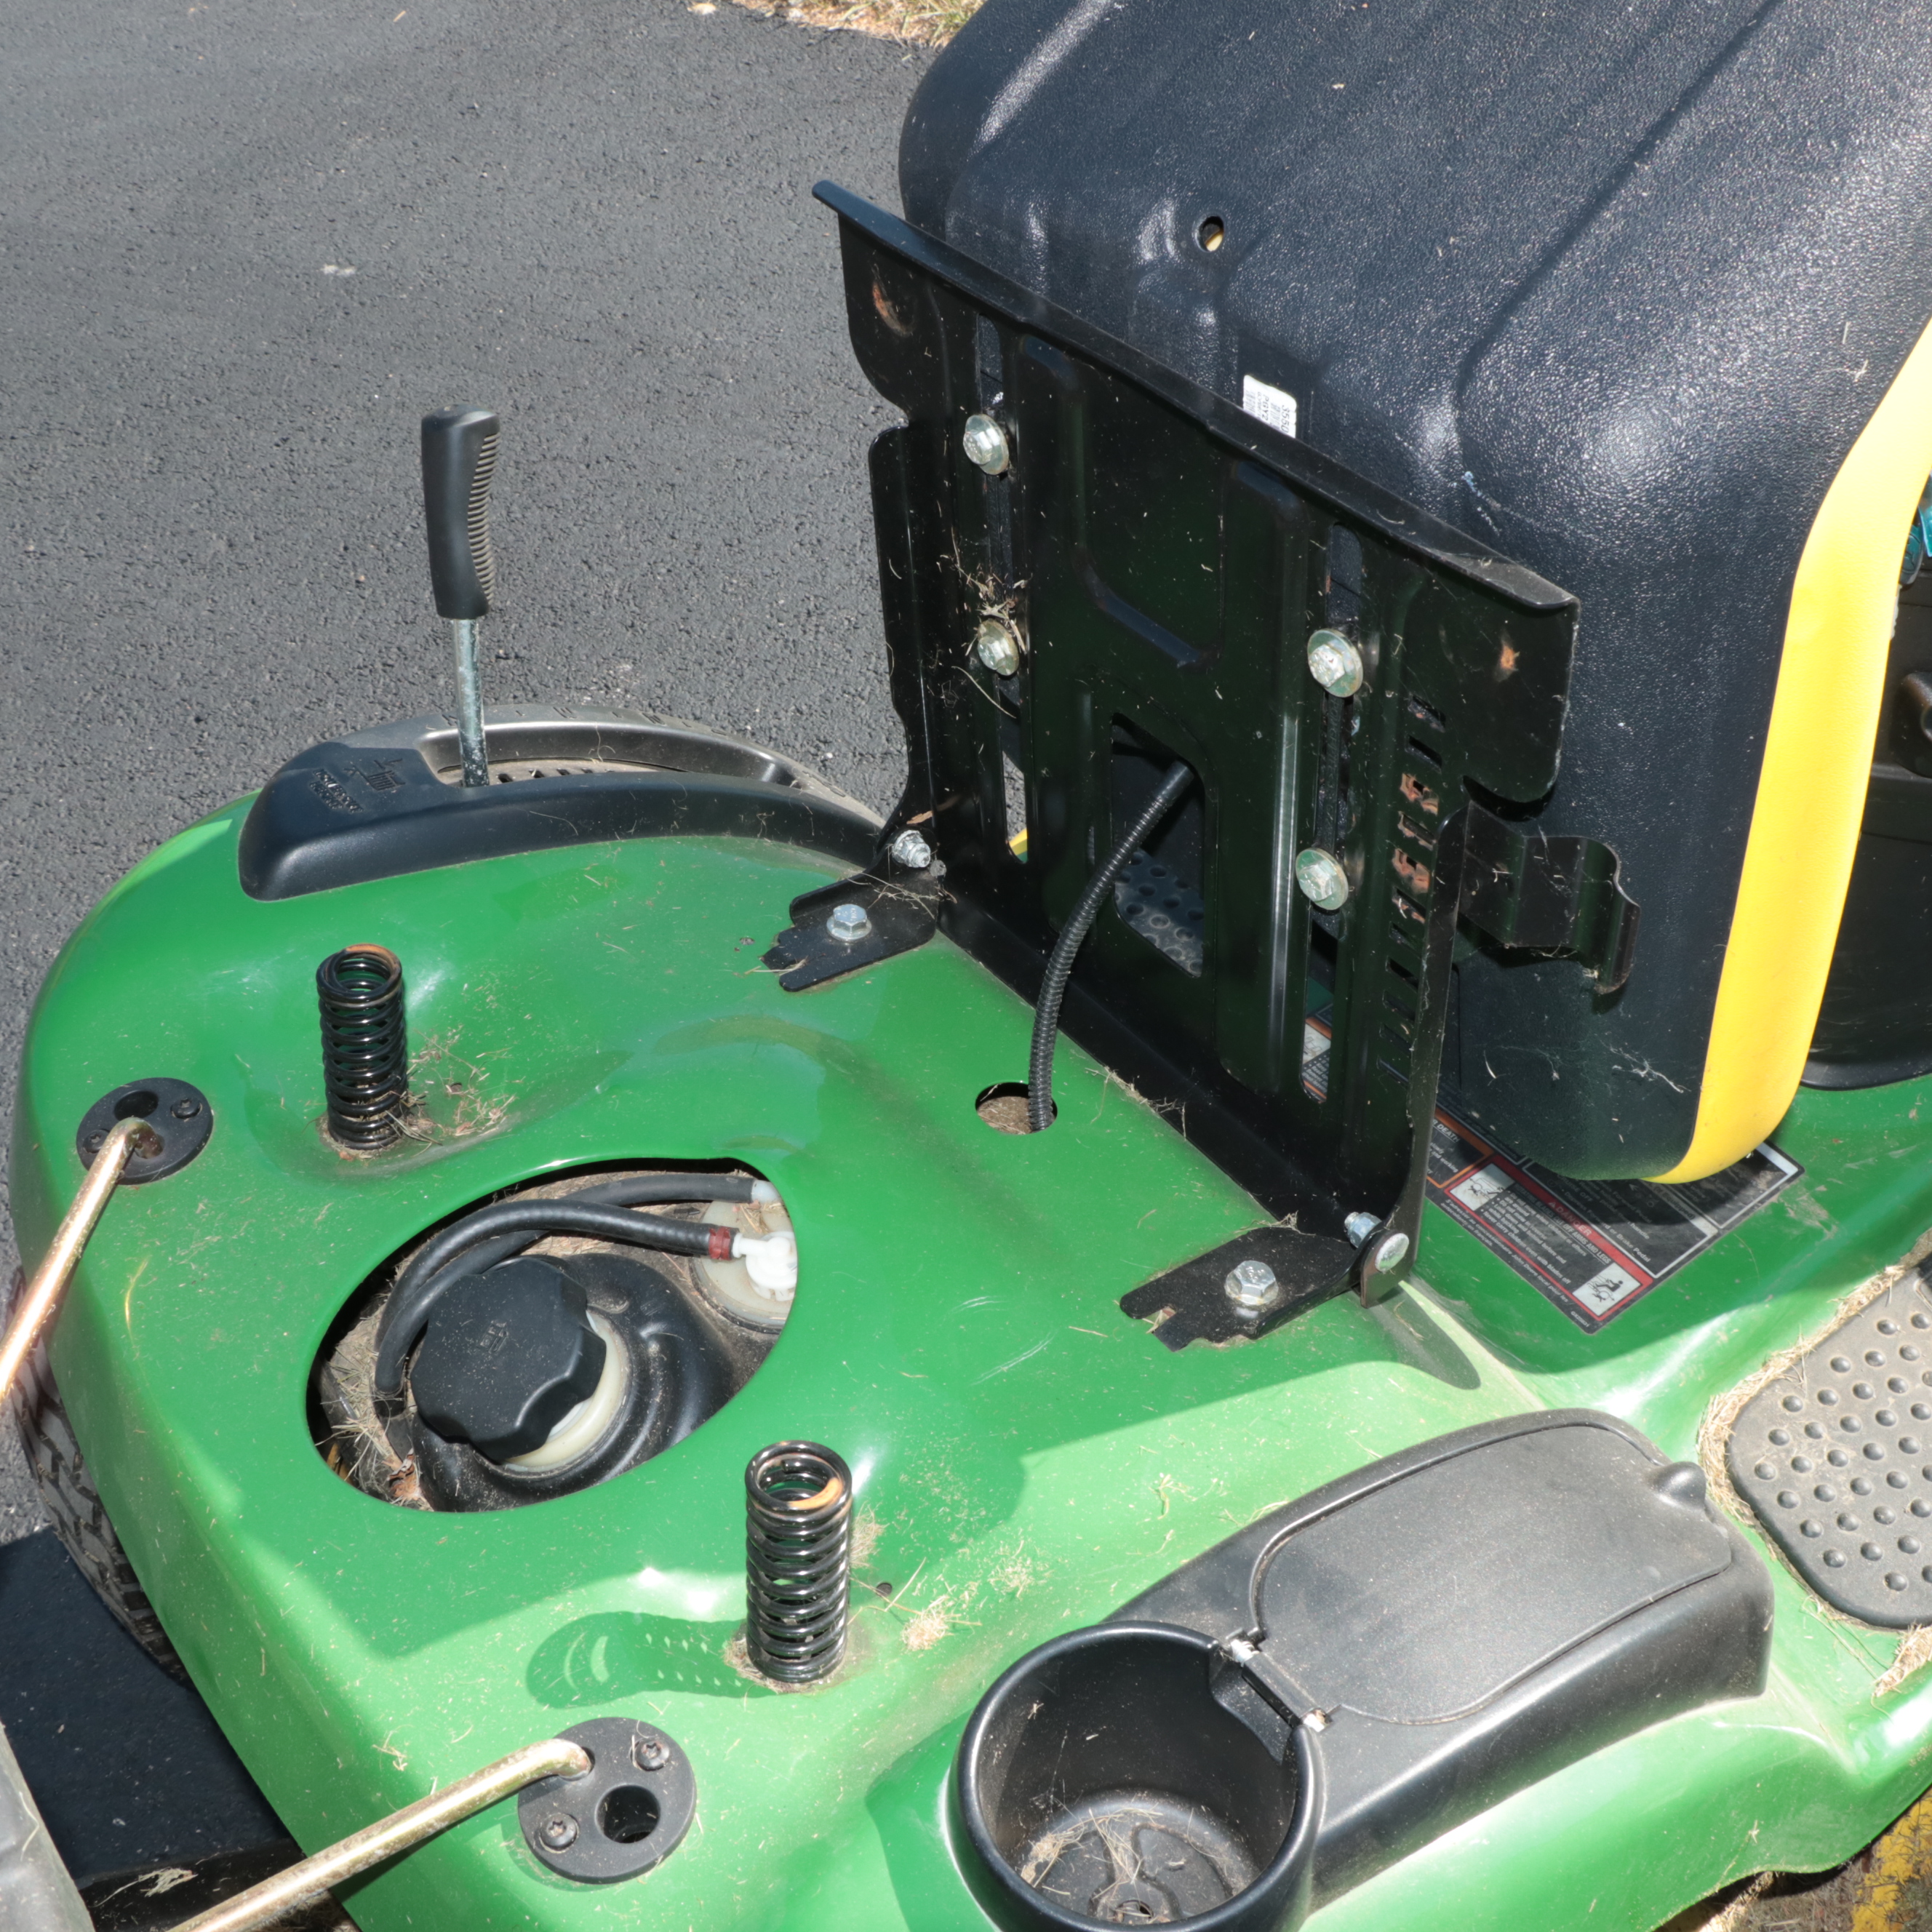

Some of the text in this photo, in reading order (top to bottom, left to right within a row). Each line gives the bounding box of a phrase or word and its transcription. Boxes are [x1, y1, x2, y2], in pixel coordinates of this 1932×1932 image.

[1437, 1123, 1461, 1143] DEATH
[1512, 1203, 1529, 1217] around
[1580, 1192, 1592, 1202] OFF
[1536, 1202, 1554, 1218] BLADES
[1554, 1216, 1563, 1225] CUT
[1563, 1224, 1574, 1233] OFF
[1572, 1232, 1588, 1245] ARMS
[1586, 1243, 1599, 1253] AND
[1597, 1252, 1611, 1264] LEGS
[1556, 1204, 1592, 1236] DANGER
[1483, 1211, 1497, 1224] Never
[1496, 1223, 1509, 1234] carry
[1508, 1232, 1526, 1248] children
[1537, 1256, 1549, 1266] with
[1547, 1265, 1563, 1279] blades
[1505, 1213, 1518, 1224] down
[1517, 1224, 1528, 1232] and
[1527, 1230, 1544, 1244] behind
[1541, 1243, 1557, 1256] before
[1556, 1256, 1567, 1264] and
[1616, 1233, 1634, 1248] Brake
[1633, 1247, 1651, 1262] Pedal
[1512, 1254, 1525, 1264] John
[1524, 1263, 1538, 1276] Deere
[1538, 1275, 1550, 1286] local
